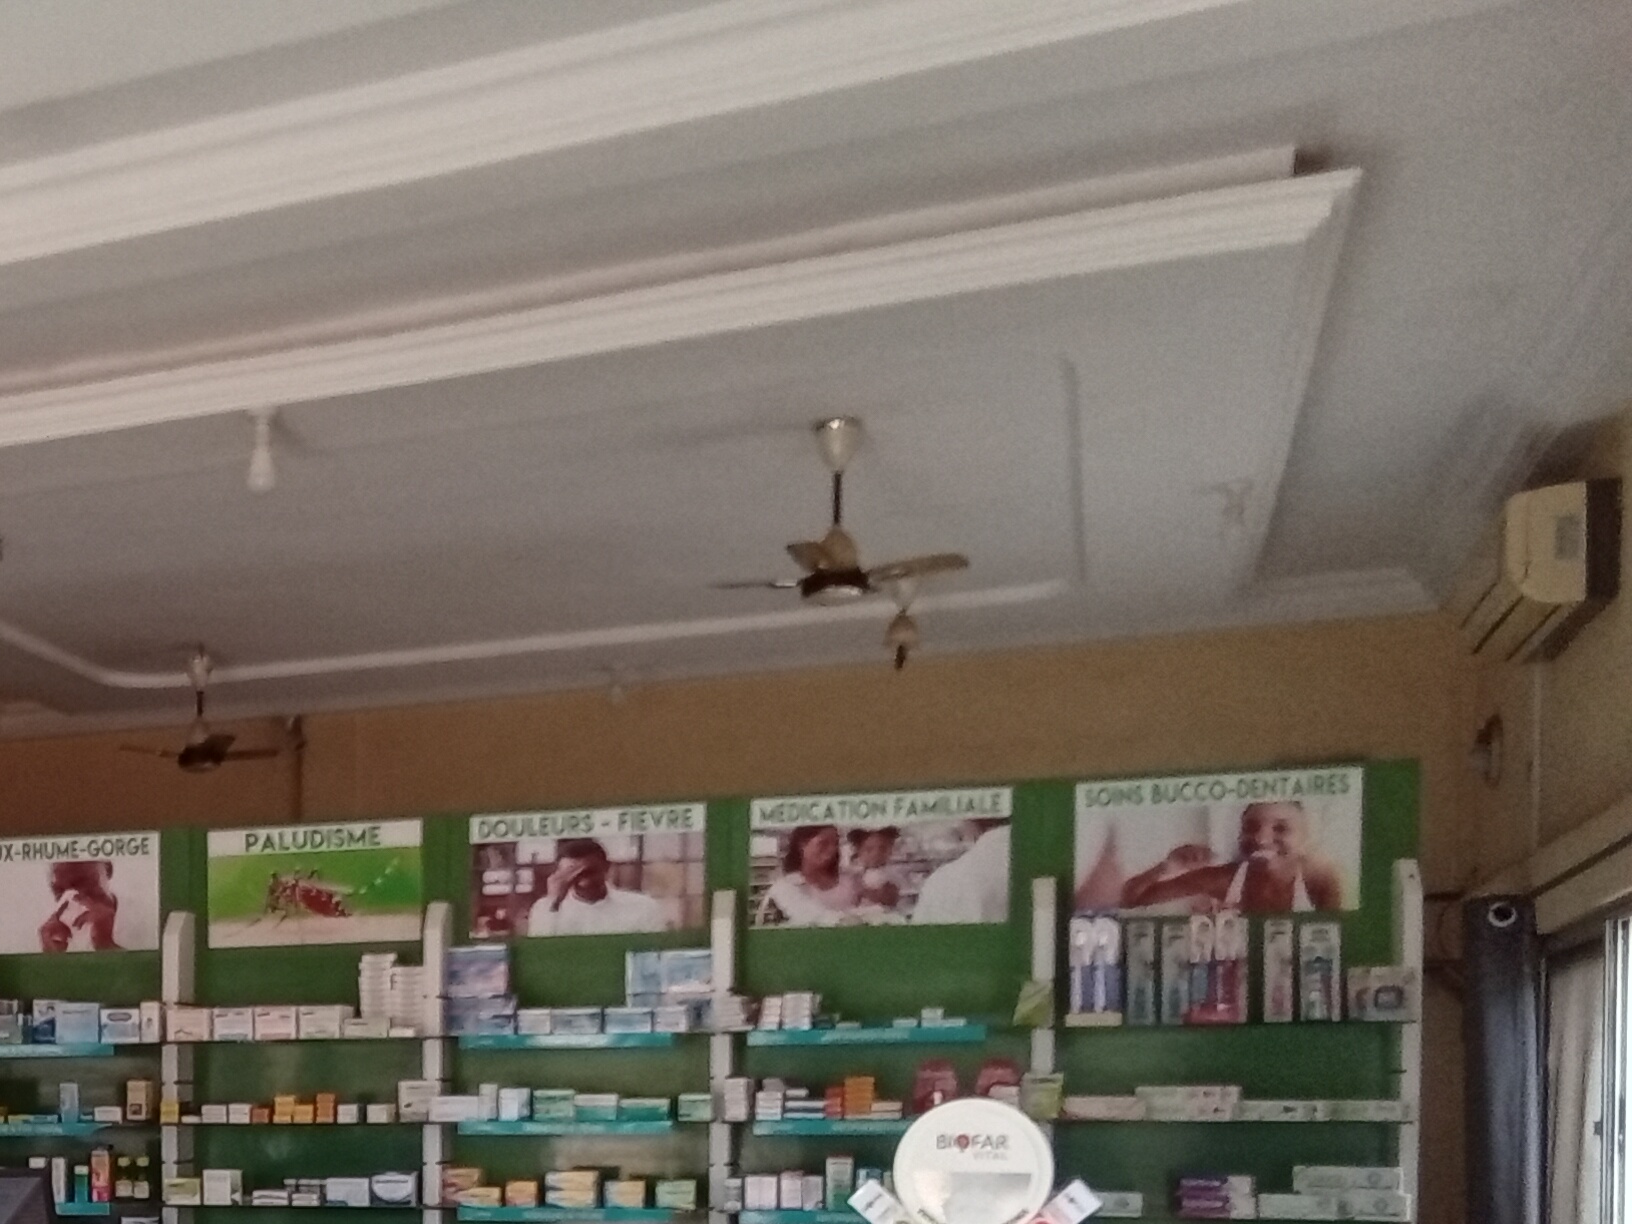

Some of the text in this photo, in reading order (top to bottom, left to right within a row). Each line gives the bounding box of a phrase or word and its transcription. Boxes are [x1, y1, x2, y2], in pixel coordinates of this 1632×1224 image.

[1085, 785, 1144, 808] SOINS
[478, 814, 595, 839] DOULEURS
[618, 808, 694, 832] FIEVRE
[759, 800, 888, 823] MEDICATION
[245, 826, 381, 852] PALUDISME
